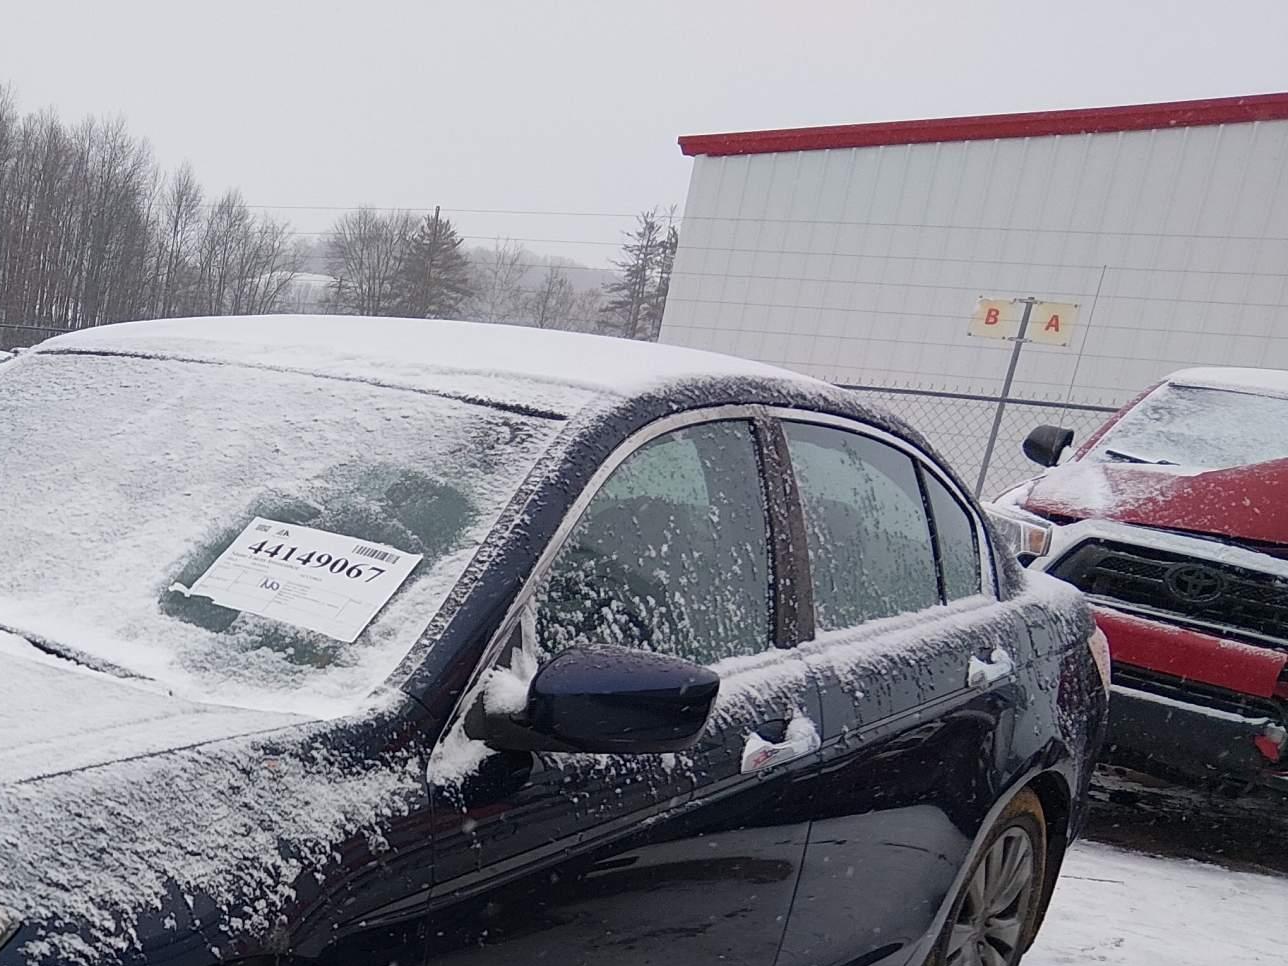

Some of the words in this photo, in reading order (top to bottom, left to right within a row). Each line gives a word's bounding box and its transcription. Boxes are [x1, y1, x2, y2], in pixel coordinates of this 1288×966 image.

[984, 308, 1000, 325] B
[1044, 314, 1060, 332] A
[247, 540, 387, 582] 44149067
